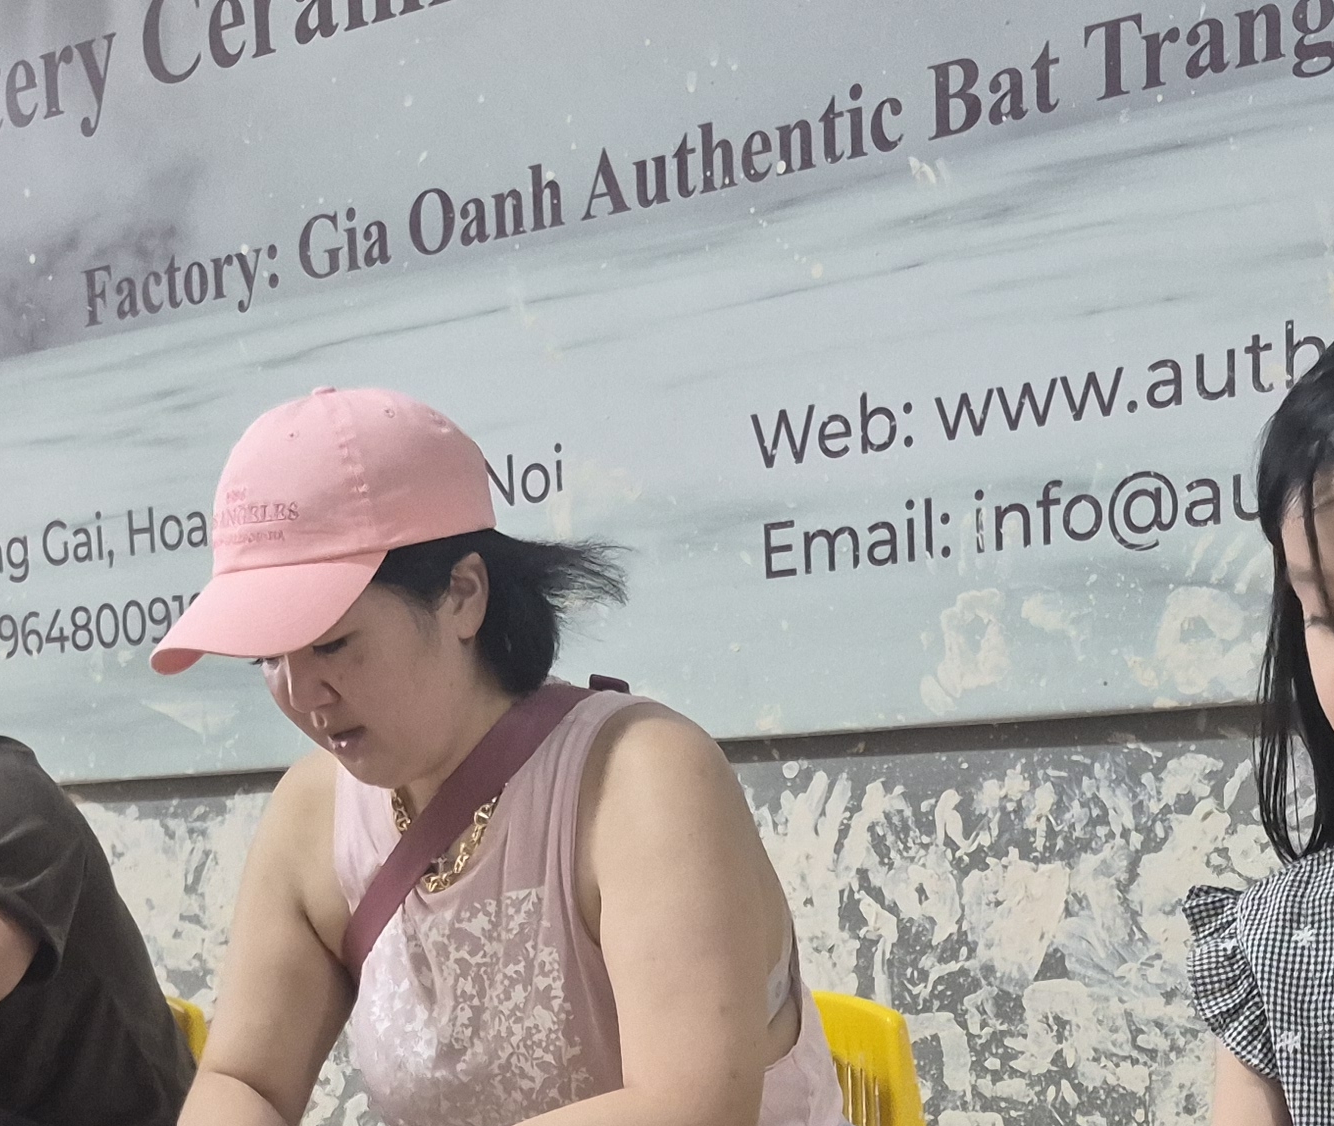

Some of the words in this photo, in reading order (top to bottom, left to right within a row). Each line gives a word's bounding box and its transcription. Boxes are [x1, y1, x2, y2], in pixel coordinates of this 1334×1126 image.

[83, 243, 281, 328] Factory:
[298, 209, 391, 280] Gia
[409, 165, 565, 256] Oanh
[580, 84, 905, 222] Authentic
[927, 41, 1061, 141] Bat
[751, 393, 914, 469] Web:
[934, 319, 1327, 441] www.auth
[42, 510, 115, 568] Gai,
[127, 506, 208, 556] Hoa
[485, 442, 563, 507] Noi
[763, 498, 951, 579] Email:
